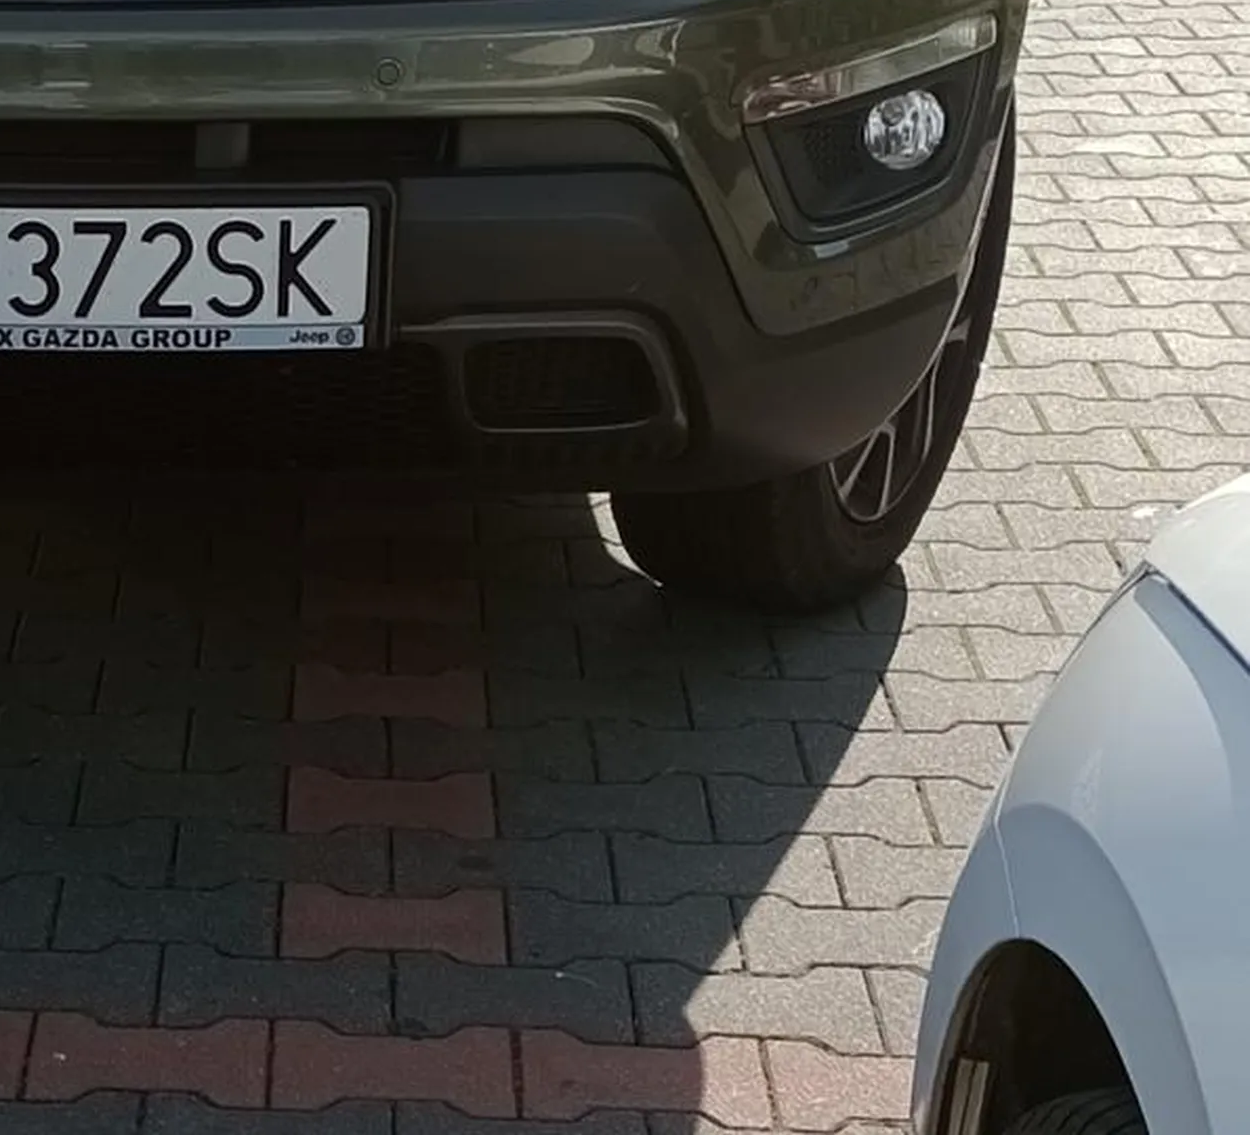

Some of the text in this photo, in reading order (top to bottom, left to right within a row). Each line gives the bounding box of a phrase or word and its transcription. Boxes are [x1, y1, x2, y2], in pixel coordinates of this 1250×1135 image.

[7, 218, 338, 319] 372SK
[21, 328, 120, 349] GAZDA
[130, 328, 232, 349] GROUP
[289, 329, 330, 345] Jeep
